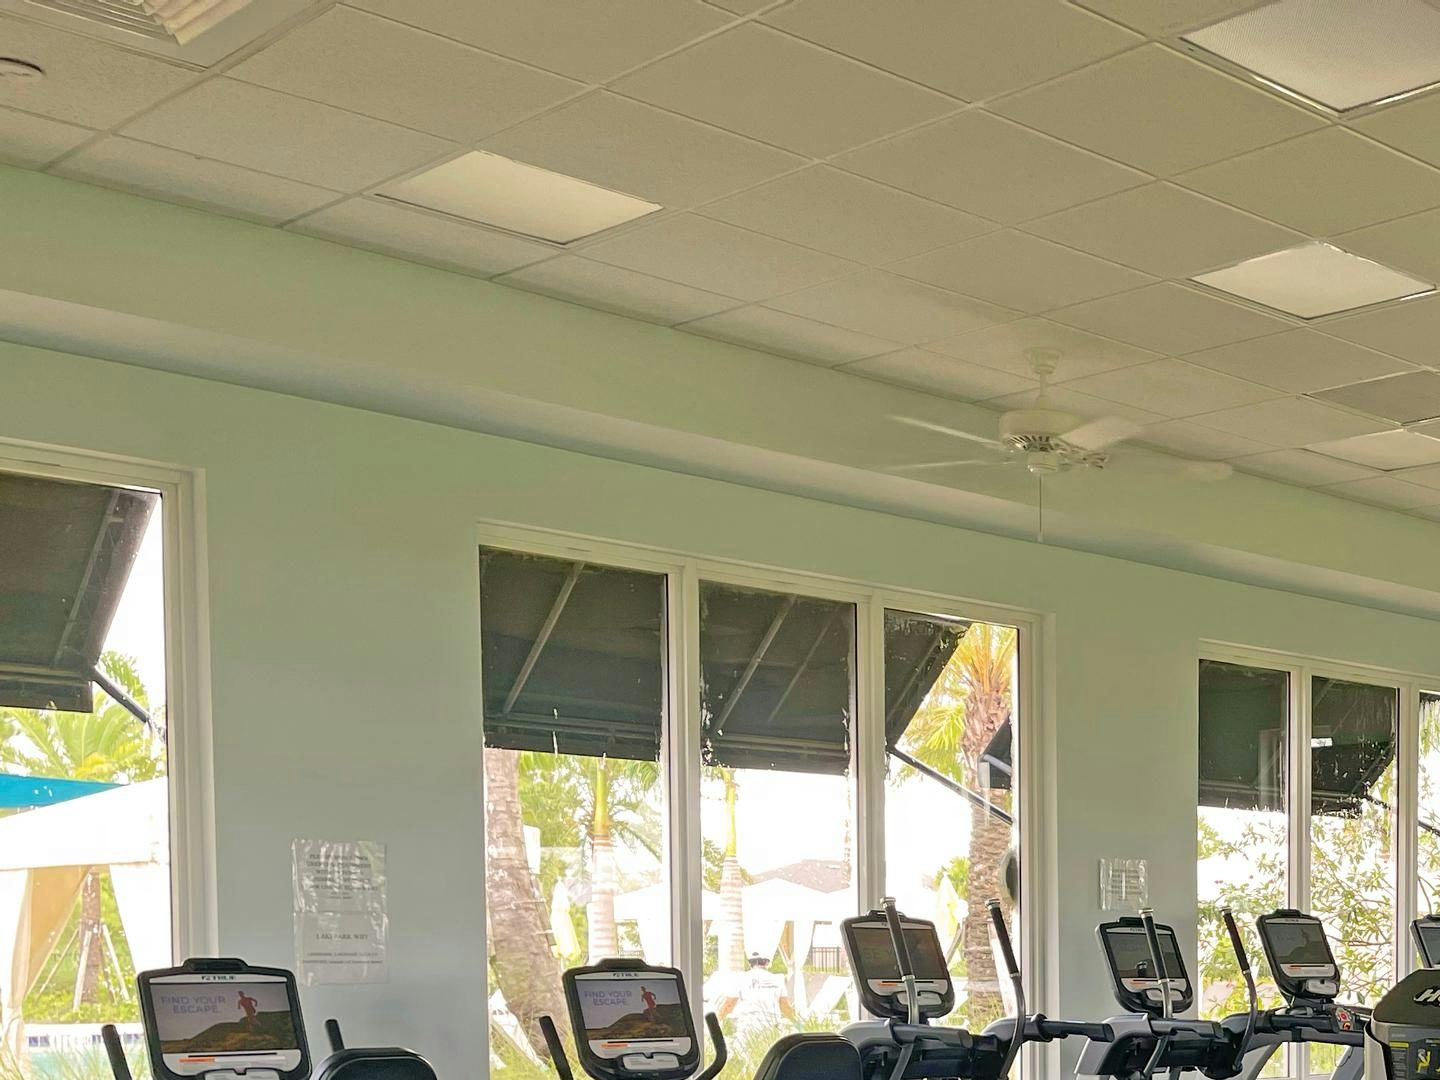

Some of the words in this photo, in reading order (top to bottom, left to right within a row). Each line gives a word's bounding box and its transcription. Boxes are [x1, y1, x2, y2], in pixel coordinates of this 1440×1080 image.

[161, 996, 191, 1005] FIND
[192, 996, 225, 1004] YOUR
[172, 1004, 218, 1013] ESCAPE
